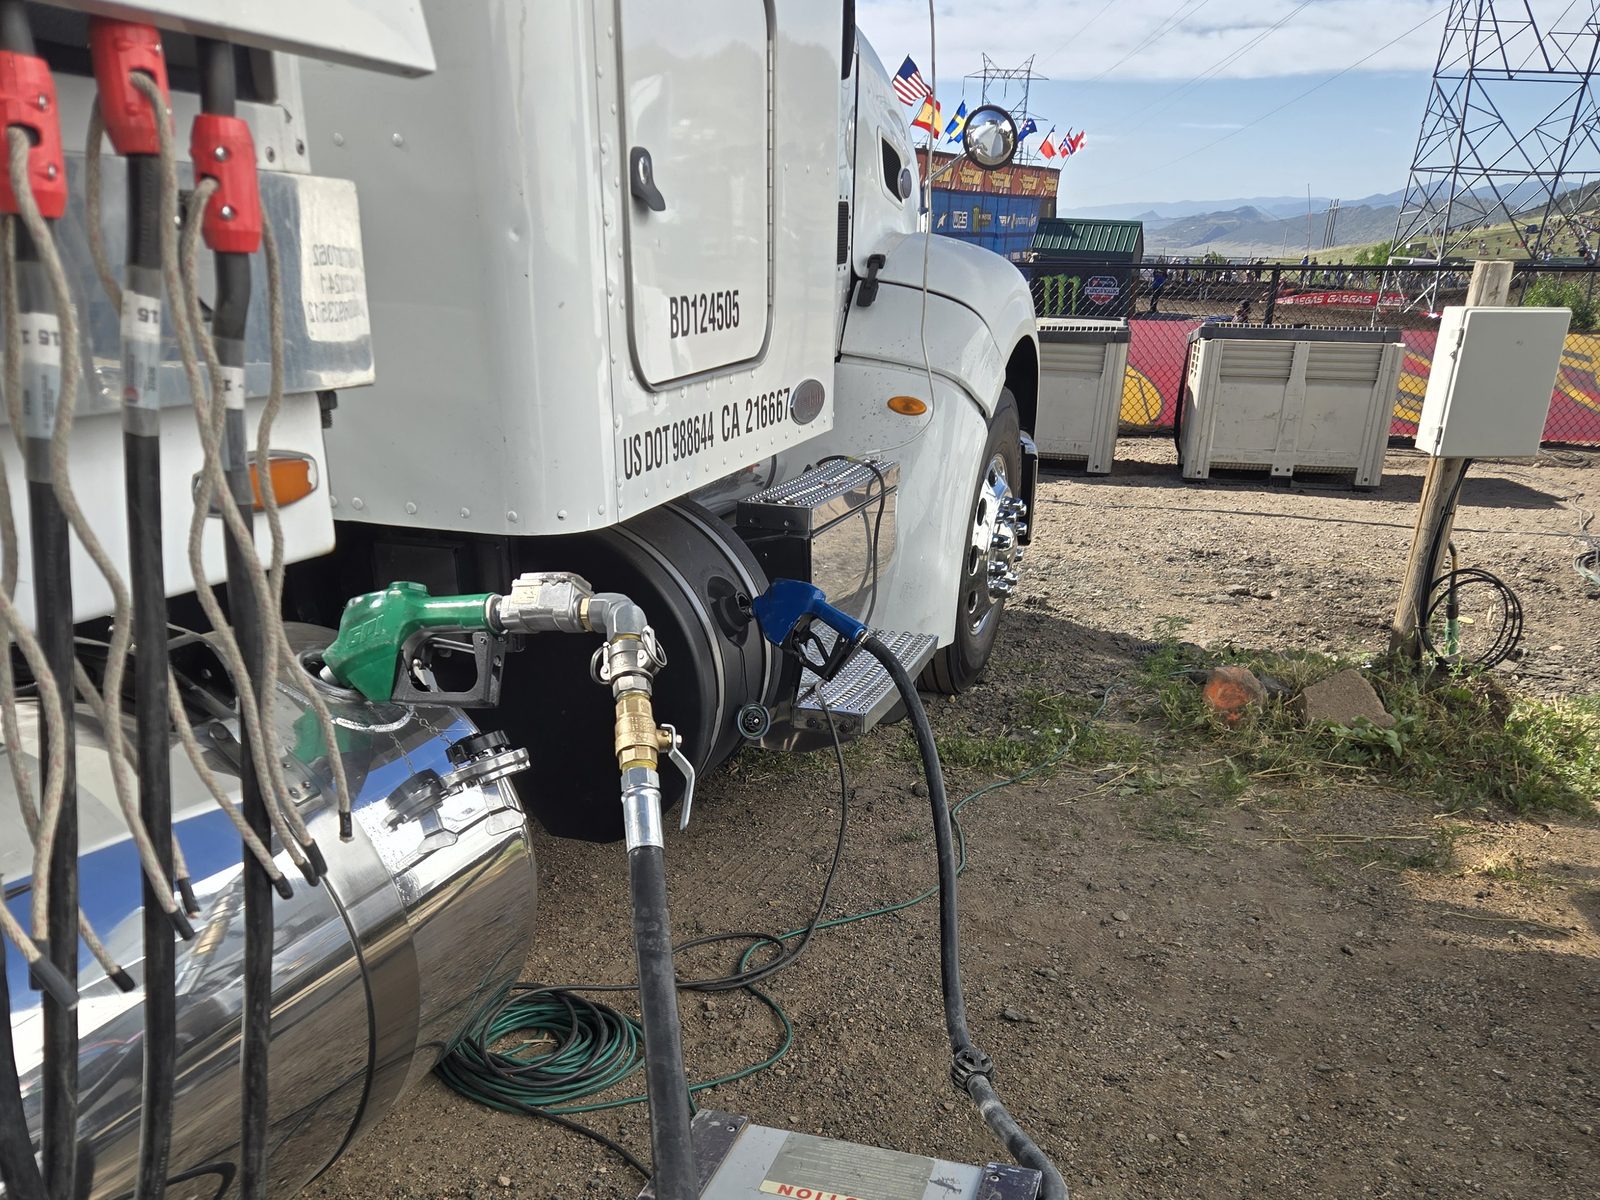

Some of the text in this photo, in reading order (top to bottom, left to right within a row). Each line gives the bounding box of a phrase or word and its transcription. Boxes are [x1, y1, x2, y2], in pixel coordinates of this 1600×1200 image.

[669, 290, 740, 339] BD124505
[672, 411, 714, 462] 988644
[721, 402, 740, 442] CA
[745, 388, 790, 434] 216667
